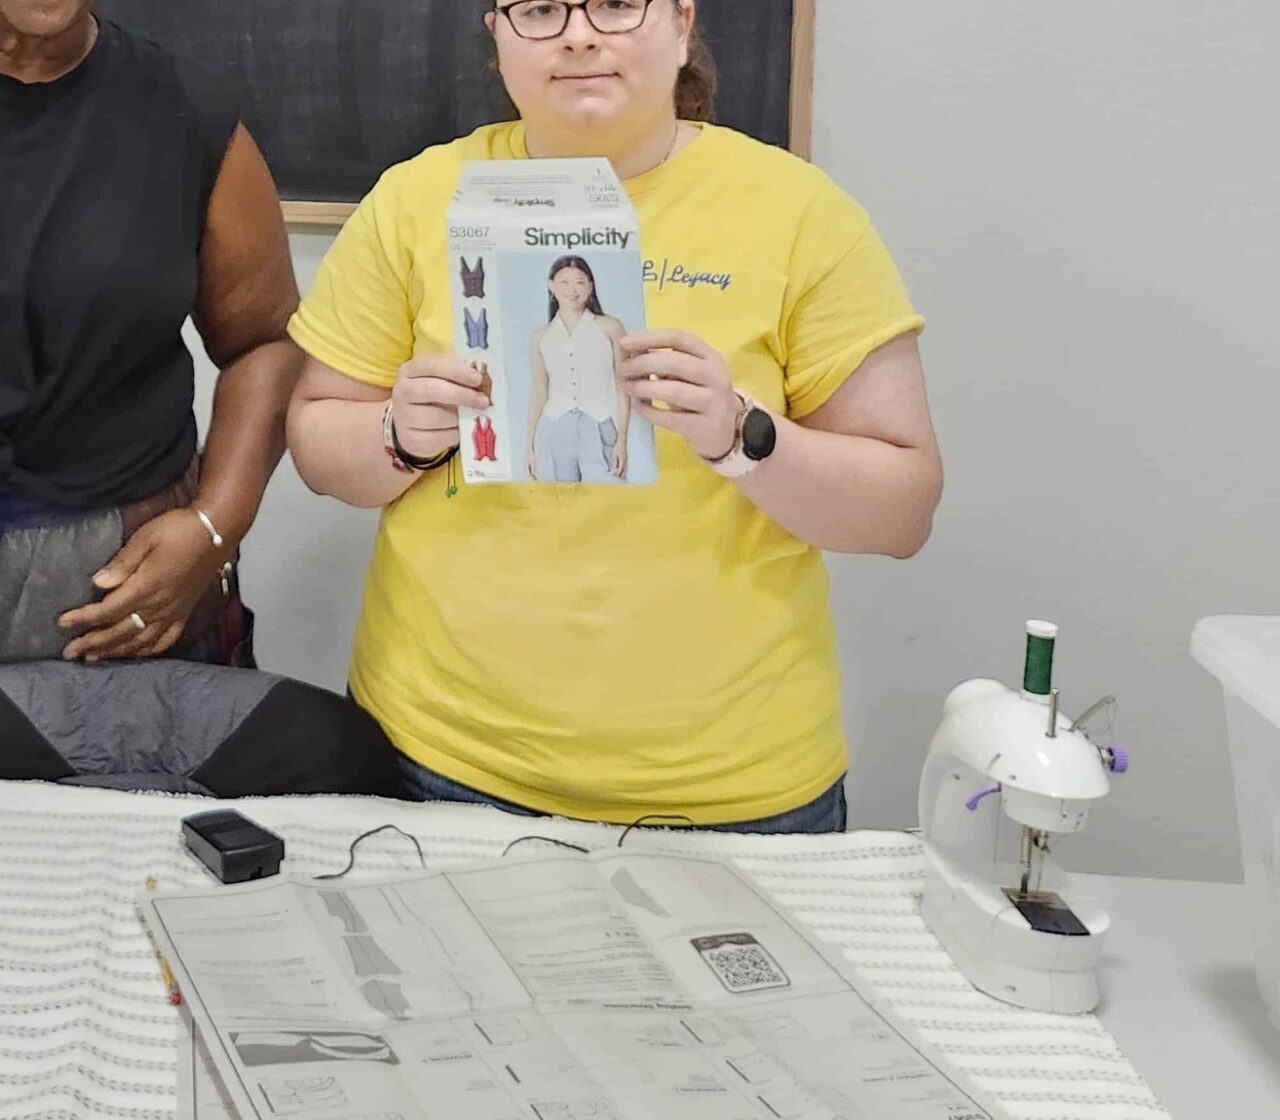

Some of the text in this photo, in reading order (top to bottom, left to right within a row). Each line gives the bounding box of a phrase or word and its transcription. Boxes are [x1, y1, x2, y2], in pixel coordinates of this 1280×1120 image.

[449, 226, 490, 238] S3067
[524, 227, 629, 249] Simplicity
[666, 264, 731, 291] Legacy
